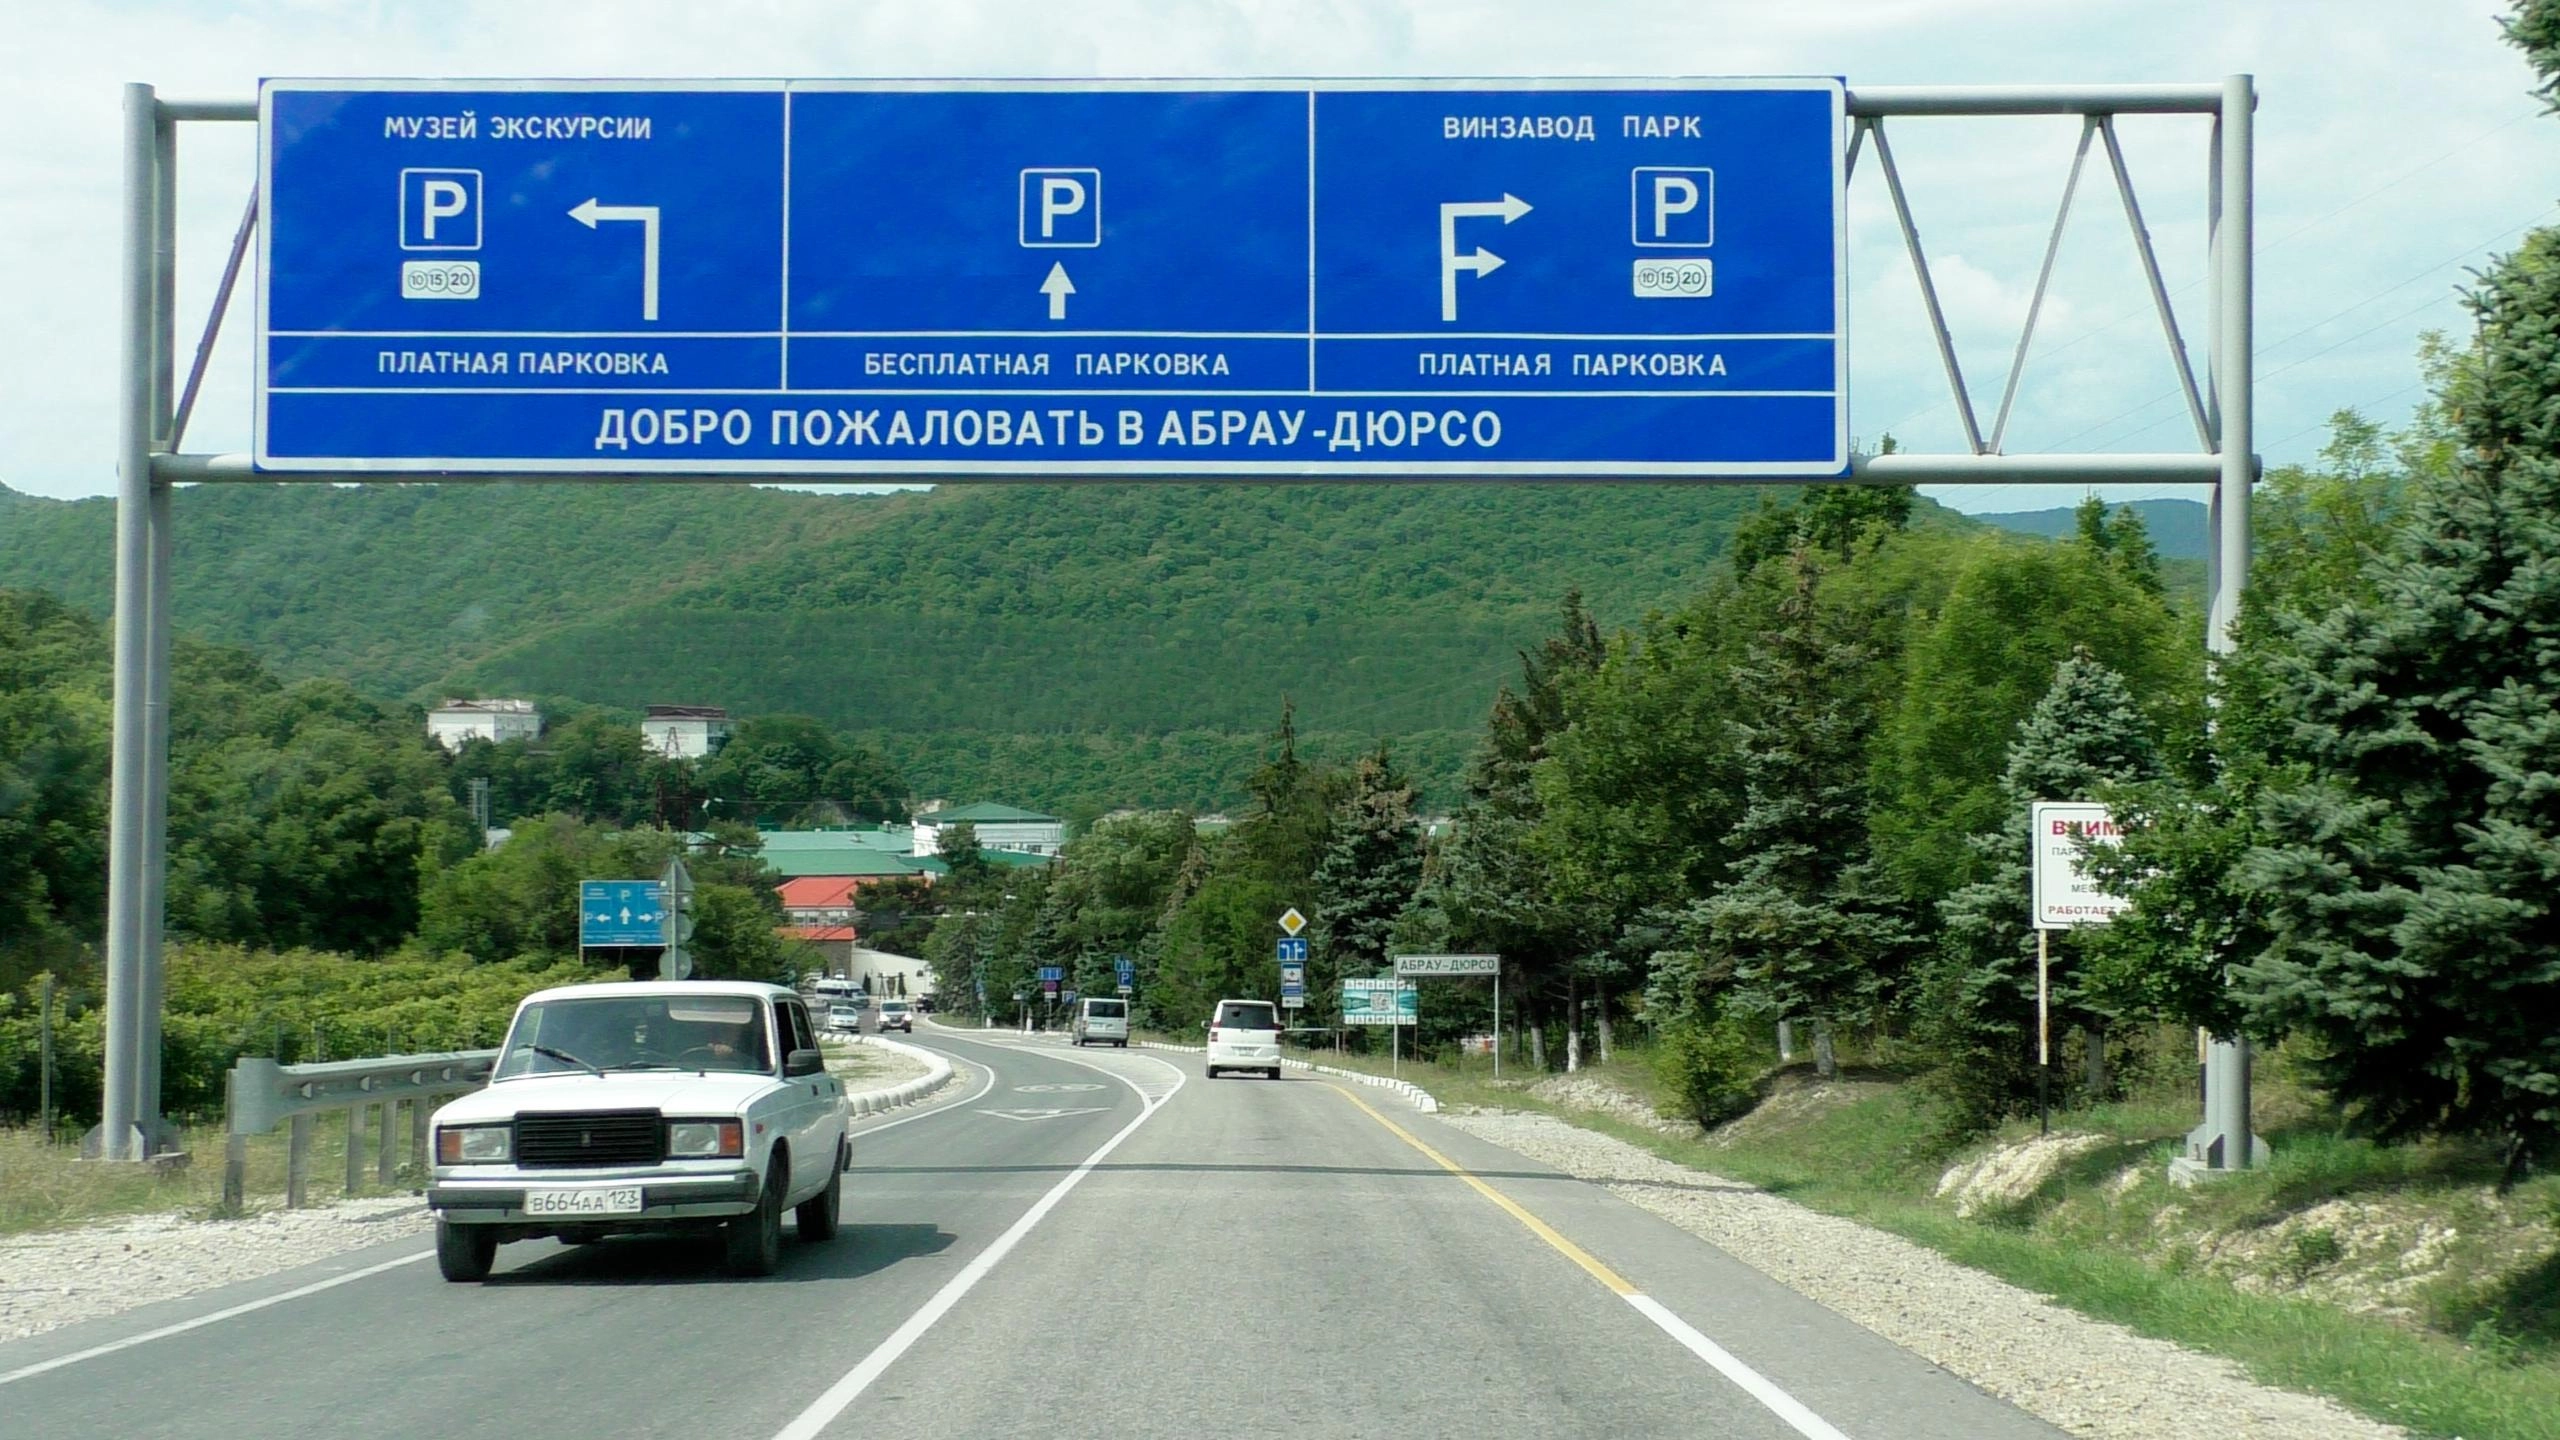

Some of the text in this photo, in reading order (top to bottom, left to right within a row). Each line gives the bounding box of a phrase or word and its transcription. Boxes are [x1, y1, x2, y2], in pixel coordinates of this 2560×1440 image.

[384, 110, 651, 140] МУЗЕЙ ЭКСКУРСИИ
[1444, 115, 1702, 141] ВИНЗАВОД ПАРК
[423, 180, 467, 240] P
[1042, 178, 1085, 237] P
[1654, 176, 1699, 237] P
[450, 272, 470, 287] 20
[1682, 271, 1702, 285] 20
[378, 351, 669, 375] ПЛАТНАЯ ПАРКОВКА
[864, 352, 1230, 376] БЕСПЛАТНАЯ ПАРКОВКА
[1418, 352, 1728, 377] ПЛАТНАЯ ПАРКОВКА
[594, 407, 1502, 453] ДОБРО ПОЖАЛОВАТЬ В АБРАУ-ДЮРСО
[1400, 959, 1495, 972] АБРАУ-ДЮРСО
[608, 1189, 640, 1206] 123
